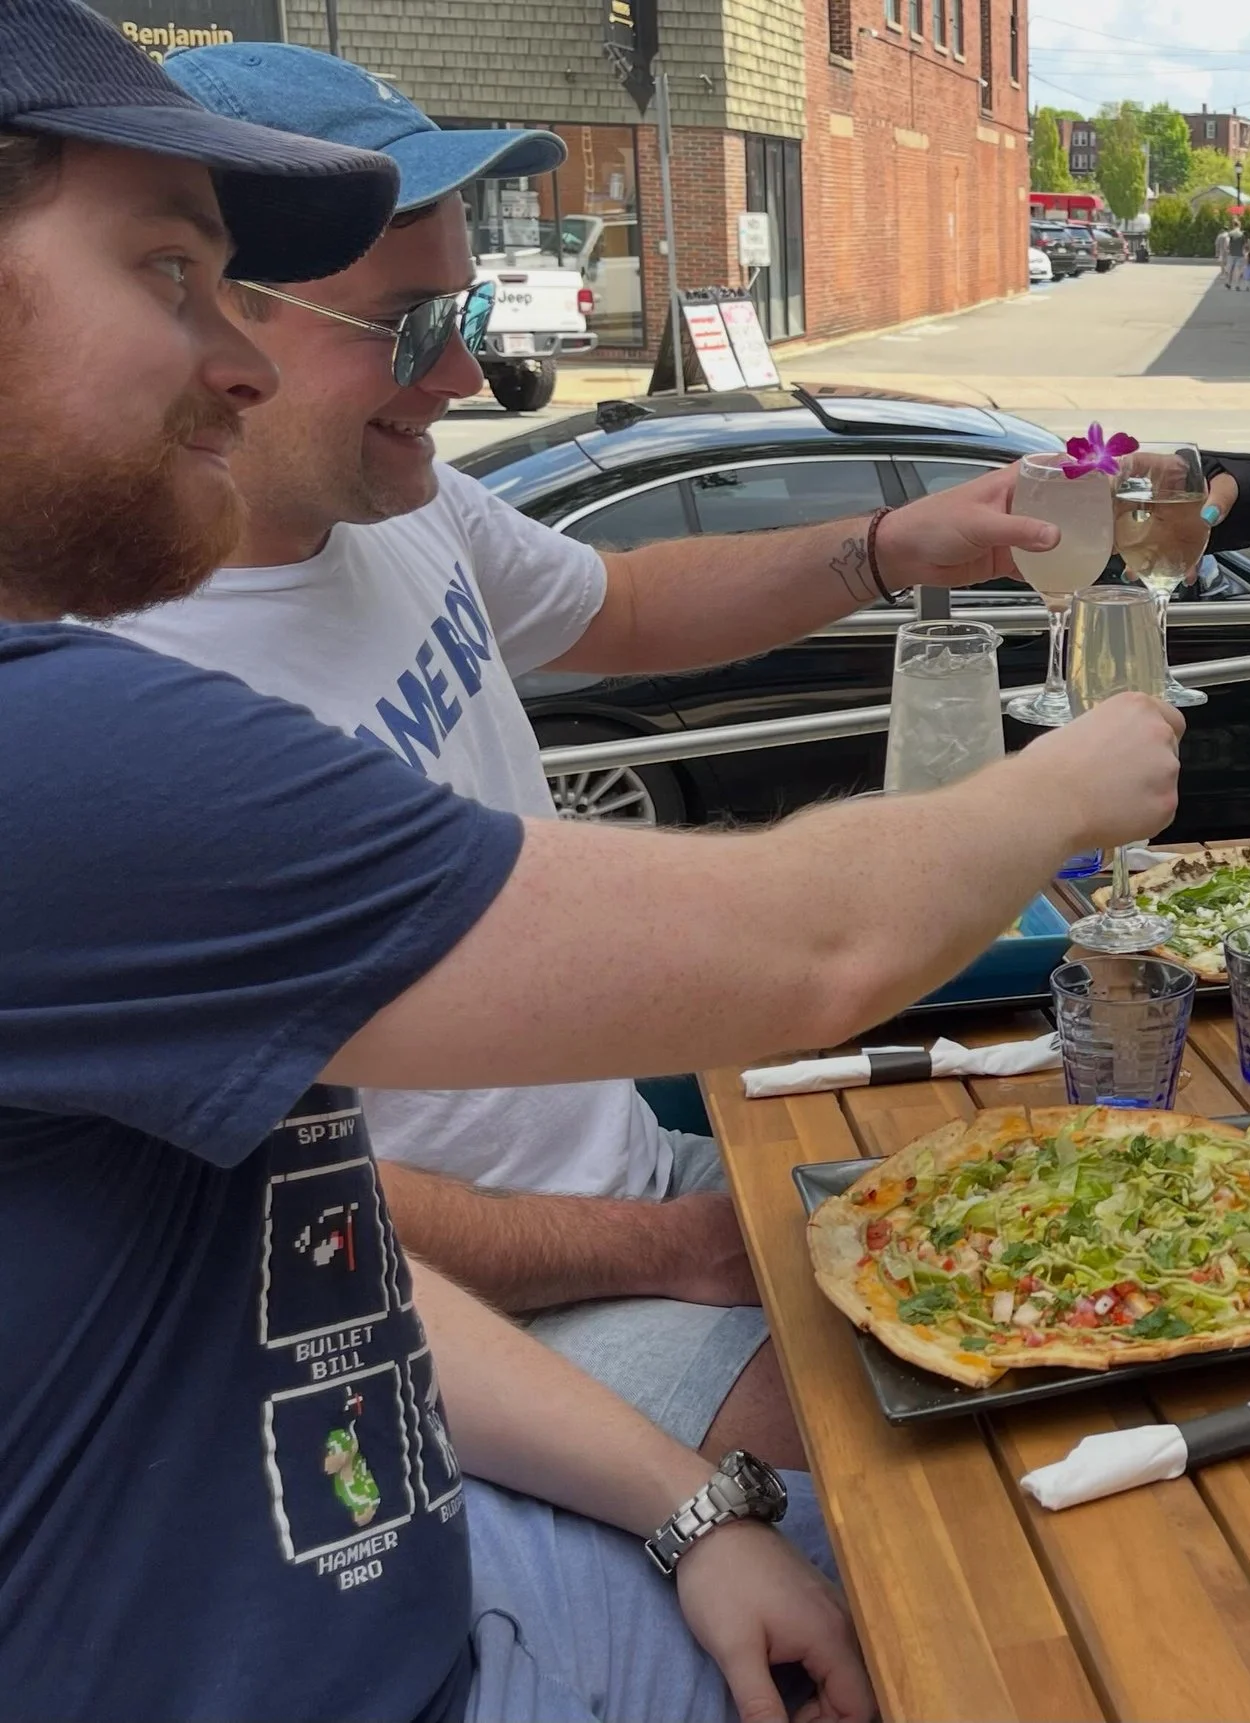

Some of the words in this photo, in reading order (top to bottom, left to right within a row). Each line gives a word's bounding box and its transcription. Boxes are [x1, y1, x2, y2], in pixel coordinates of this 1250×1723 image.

[122, 21, 234, 51] Benjamin
[498, 291, 533, 305] Jeep
[297, 1118, 355, 1145] SPINY
[296, 1325, 373, 1363] BULLET
[312, 1351, 365, 1380] BILL
[318, 1530, 398, 1576] HAMMER
[340, 1559, 383, 1590] BRO
